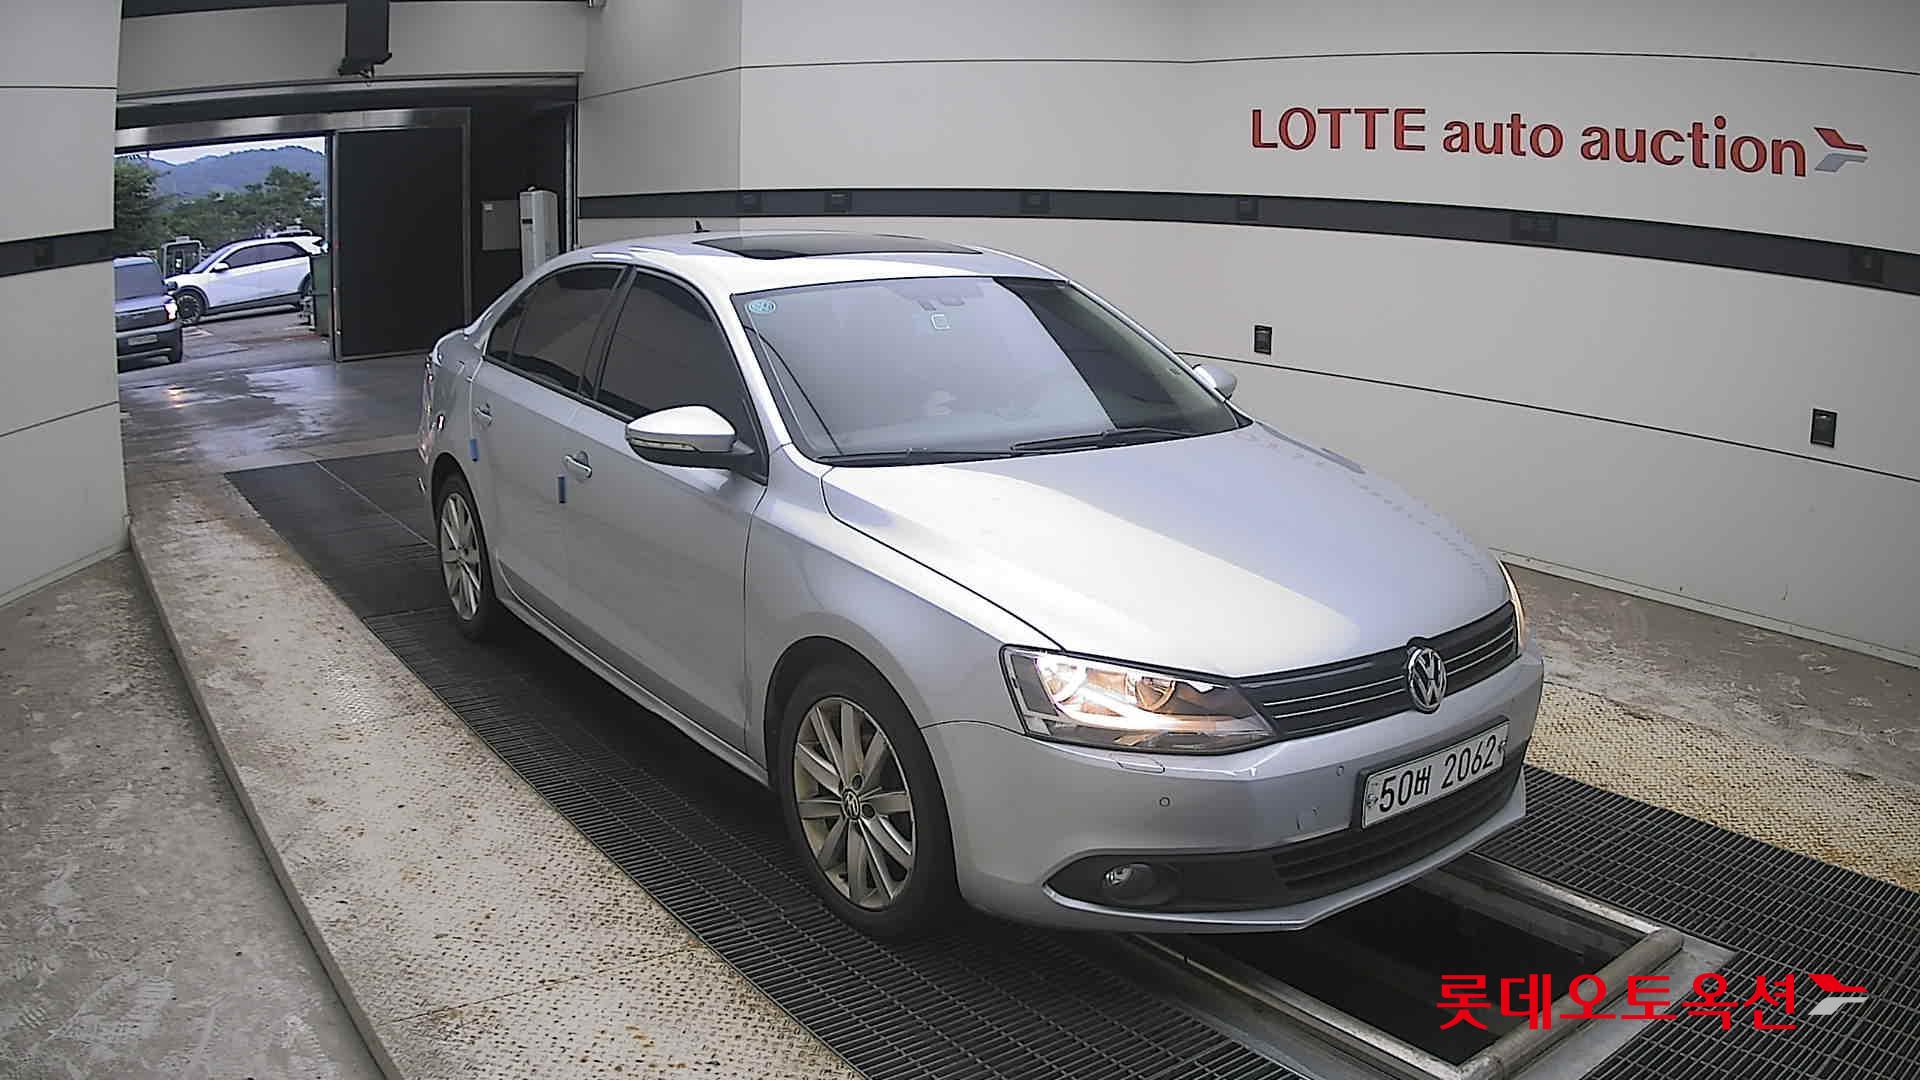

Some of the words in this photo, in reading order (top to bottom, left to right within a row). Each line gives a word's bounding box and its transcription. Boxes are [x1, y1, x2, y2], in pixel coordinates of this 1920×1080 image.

[1251, 108, 1426, 151] LOTTE
[1443, 113, 1563, 157] auto
[1581, 117, 1807, 176] auction
[1379, 765, 1432, 812] 50버
[1441, 735, 1496, 789] 2062
